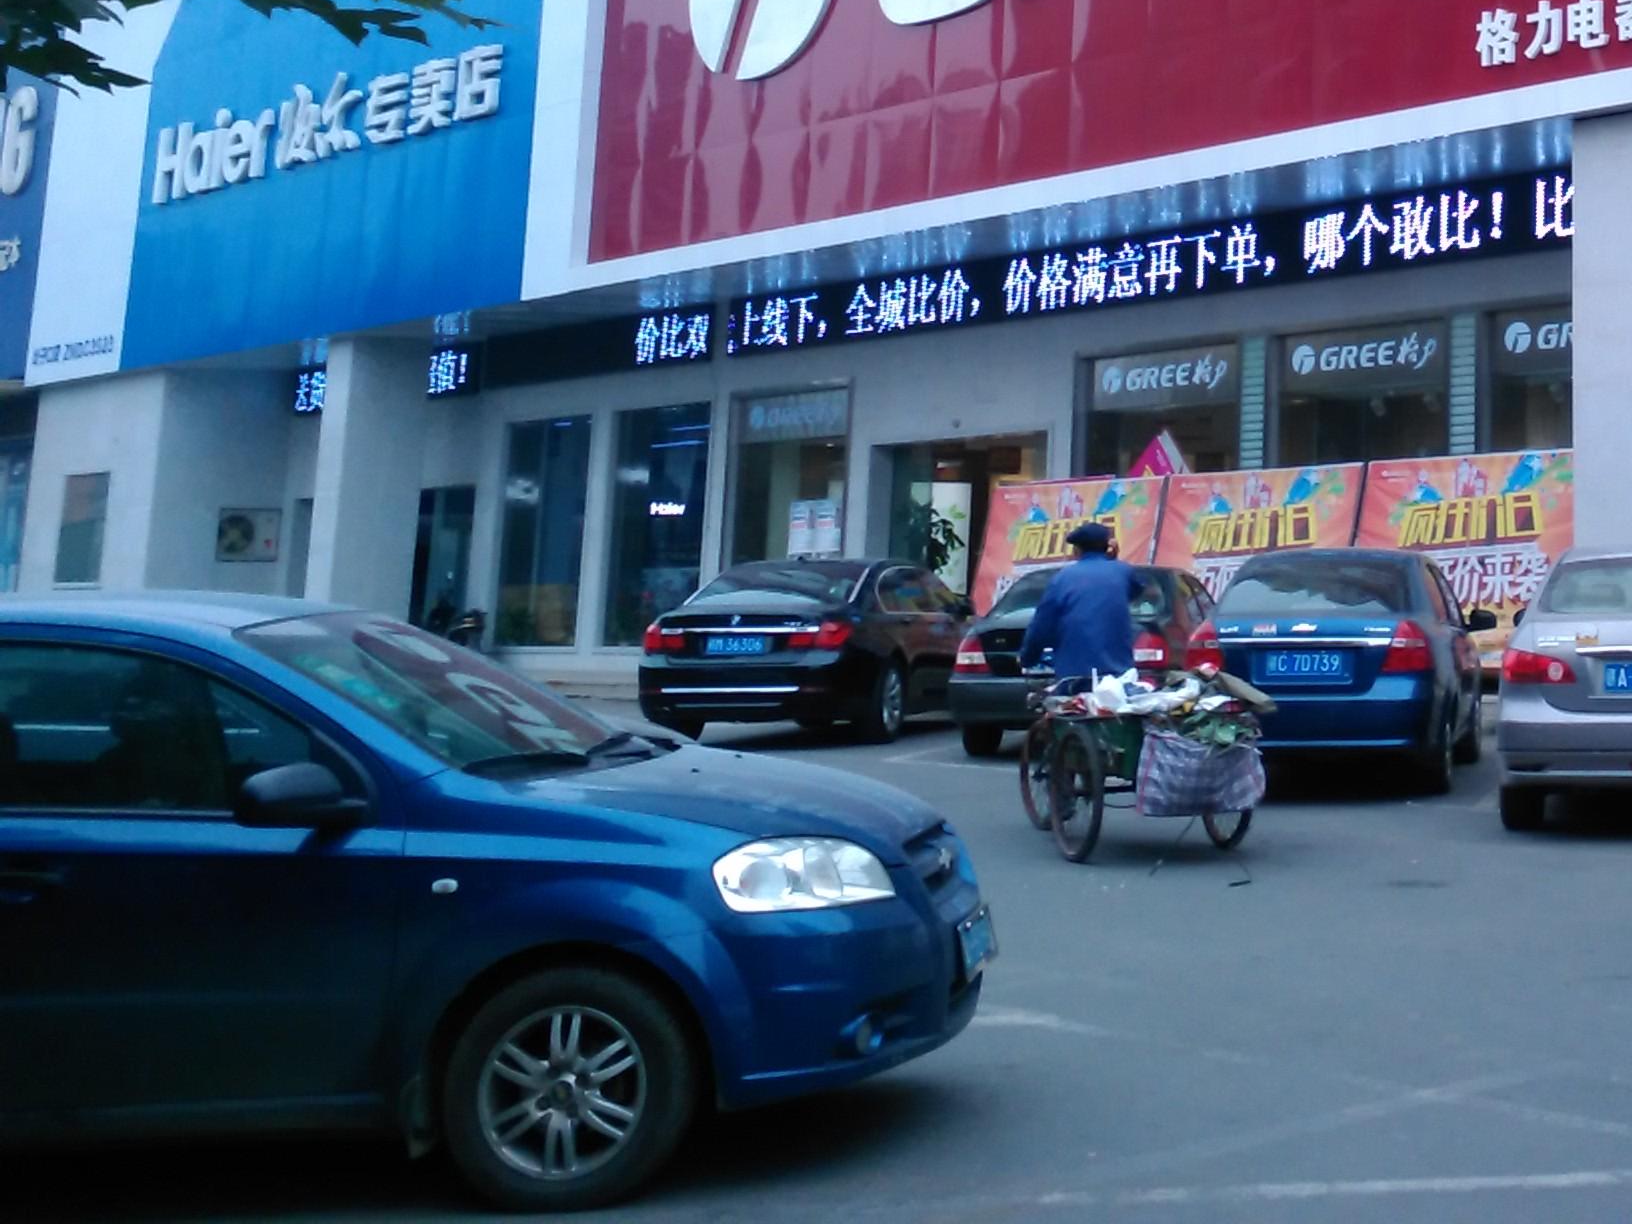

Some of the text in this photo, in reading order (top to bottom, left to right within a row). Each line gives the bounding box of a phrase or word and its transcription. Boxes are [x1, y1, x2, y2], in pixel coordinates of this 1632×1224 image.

[0, 85, 39, 196] G
[152, 43, 505, 206] Haier 海尔专卖店
[1125, 362, 1190, 392] GREE
[1319, 339, 1395, 372] GREE
